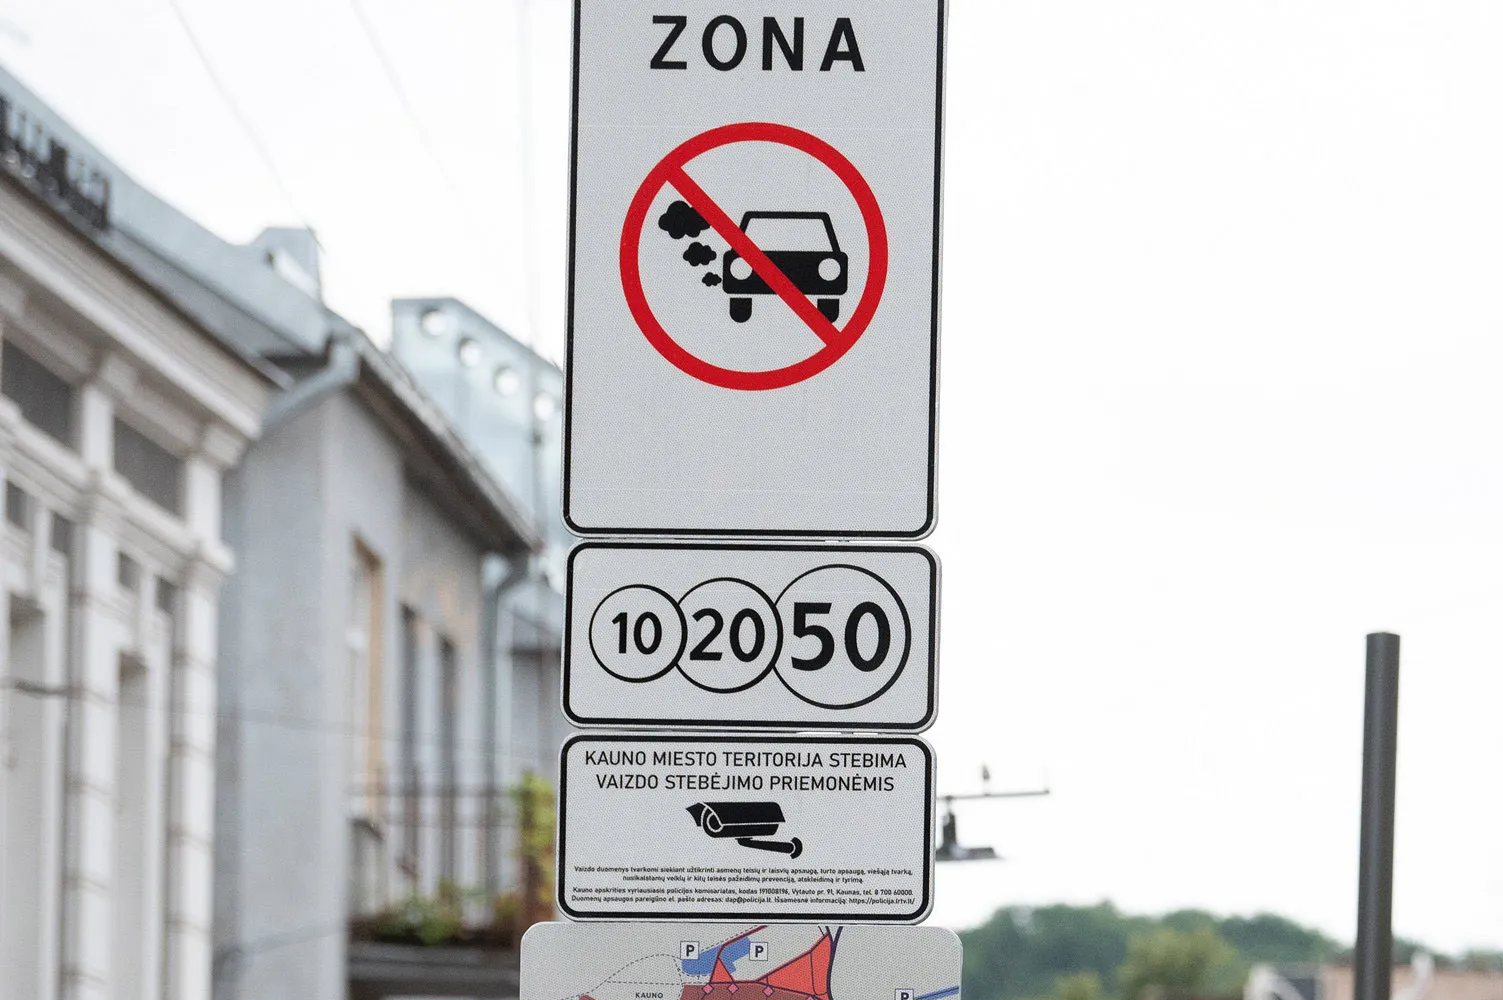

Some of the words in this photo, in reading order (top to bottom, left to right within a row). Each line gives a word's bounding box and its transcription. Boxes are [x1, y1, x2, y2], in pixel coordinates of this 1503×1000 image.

[650, 15, 866, 72] ZONA
[612, 612, 662, 655] 10
[690, 608, 765, 662] 20
[792, 601, 891, 672] 50
[585, 750, 646, 766] KAUNO
[653, 751, 717, 766] MIESTO
[722, 751, 823, 767] TERITORIJA
[829, 752, 907, 768] STEBIMA
[596, 774, 659, 789] VAIZDO
[665, 772, 763, 790] STEBĖJIMO
[769, 773, 894, 791] PRIEMONĖMIS
